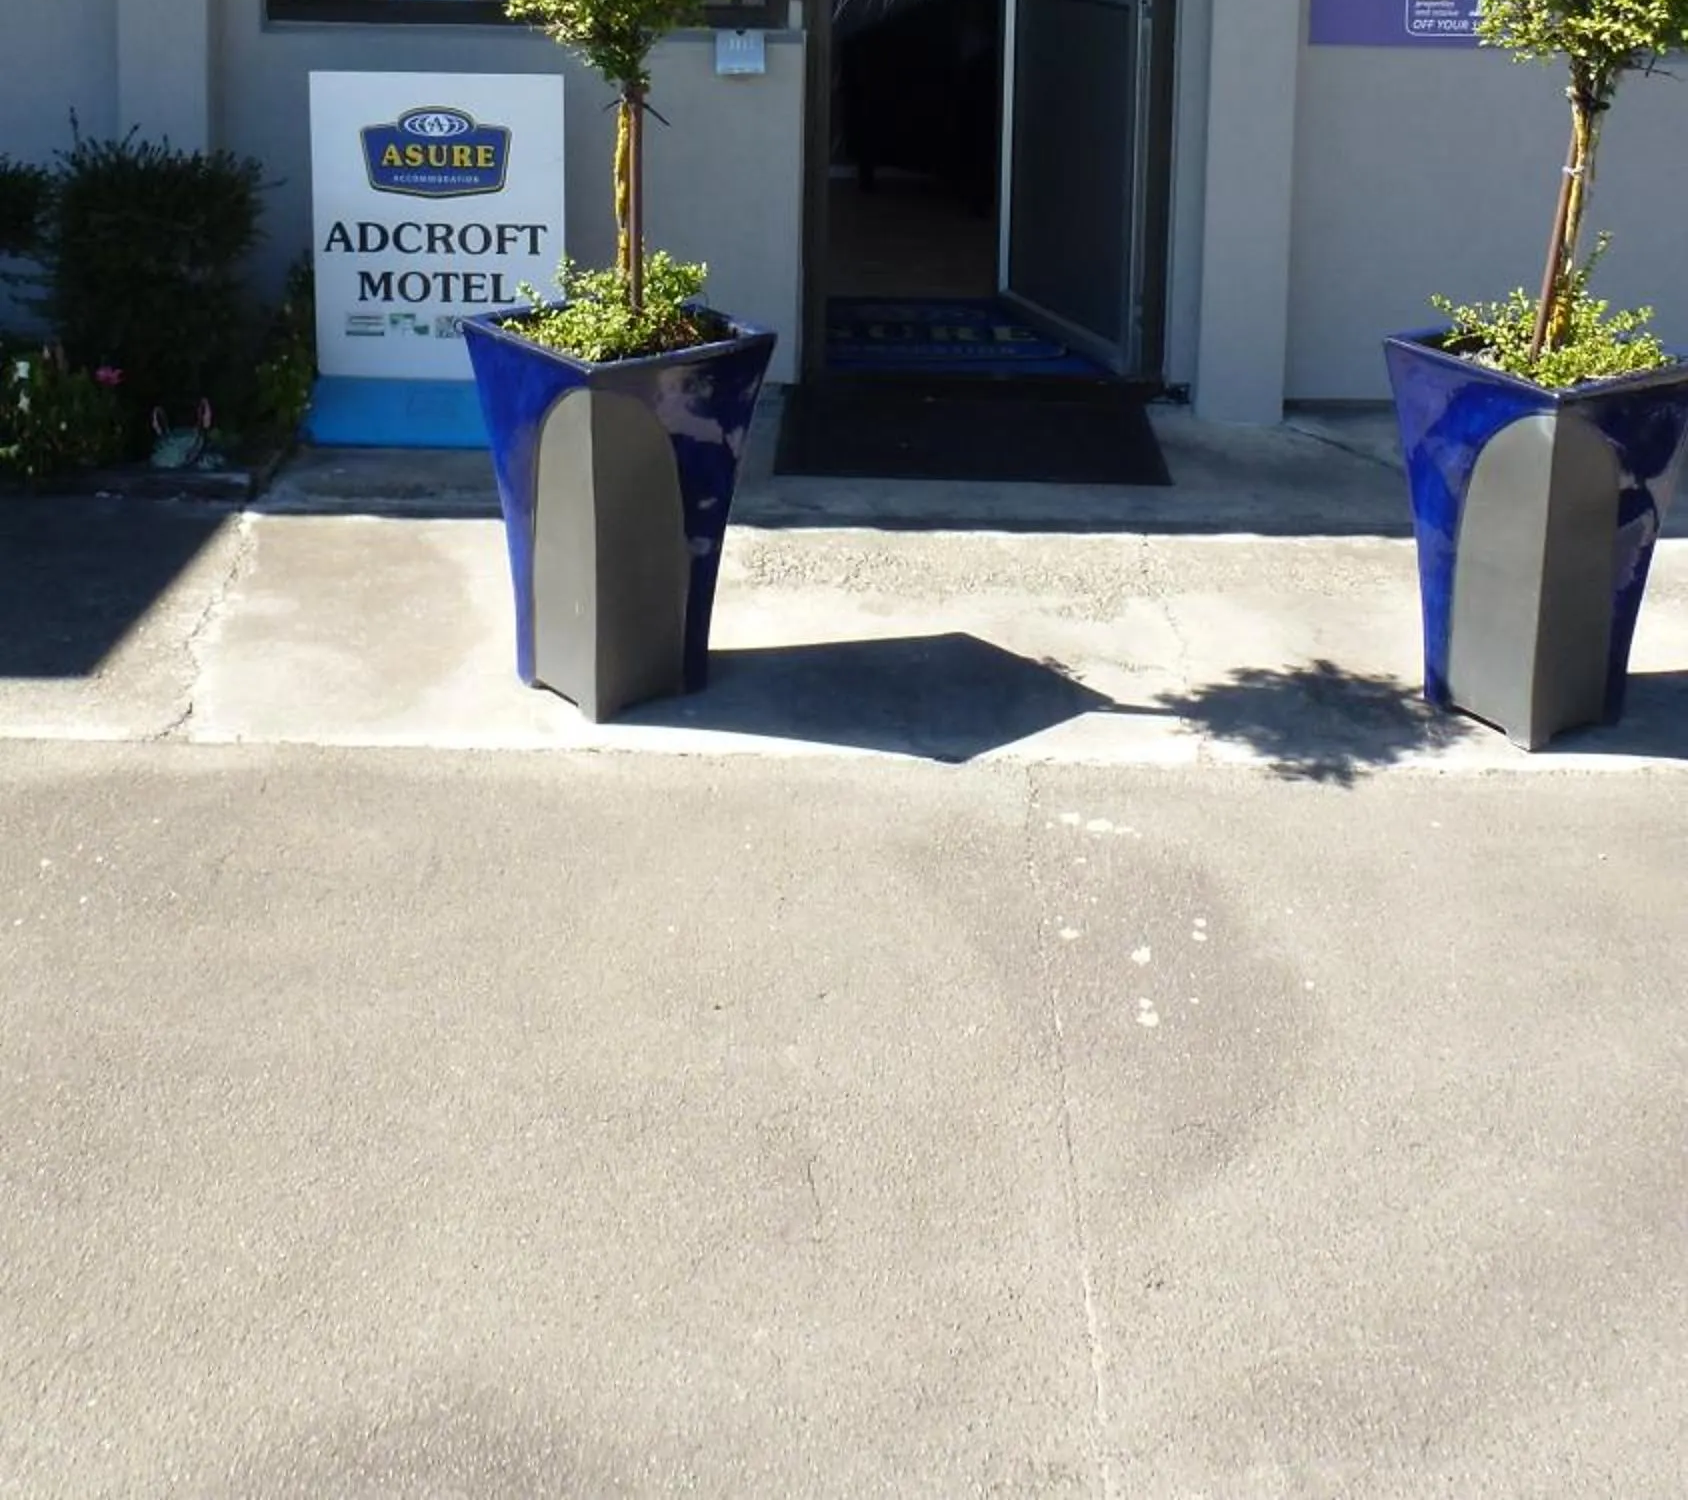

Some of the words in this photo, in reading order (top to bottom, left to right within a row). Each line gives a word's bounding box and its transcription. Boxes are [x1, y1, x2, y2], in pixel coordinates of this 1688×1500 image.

[1437, 19, 1470, 30] YOUR
[382, 144, 495, 168] ASURE
[324, 221, 548, 255] ADCROFT
[357, 271, 516, 304] MOTEL
